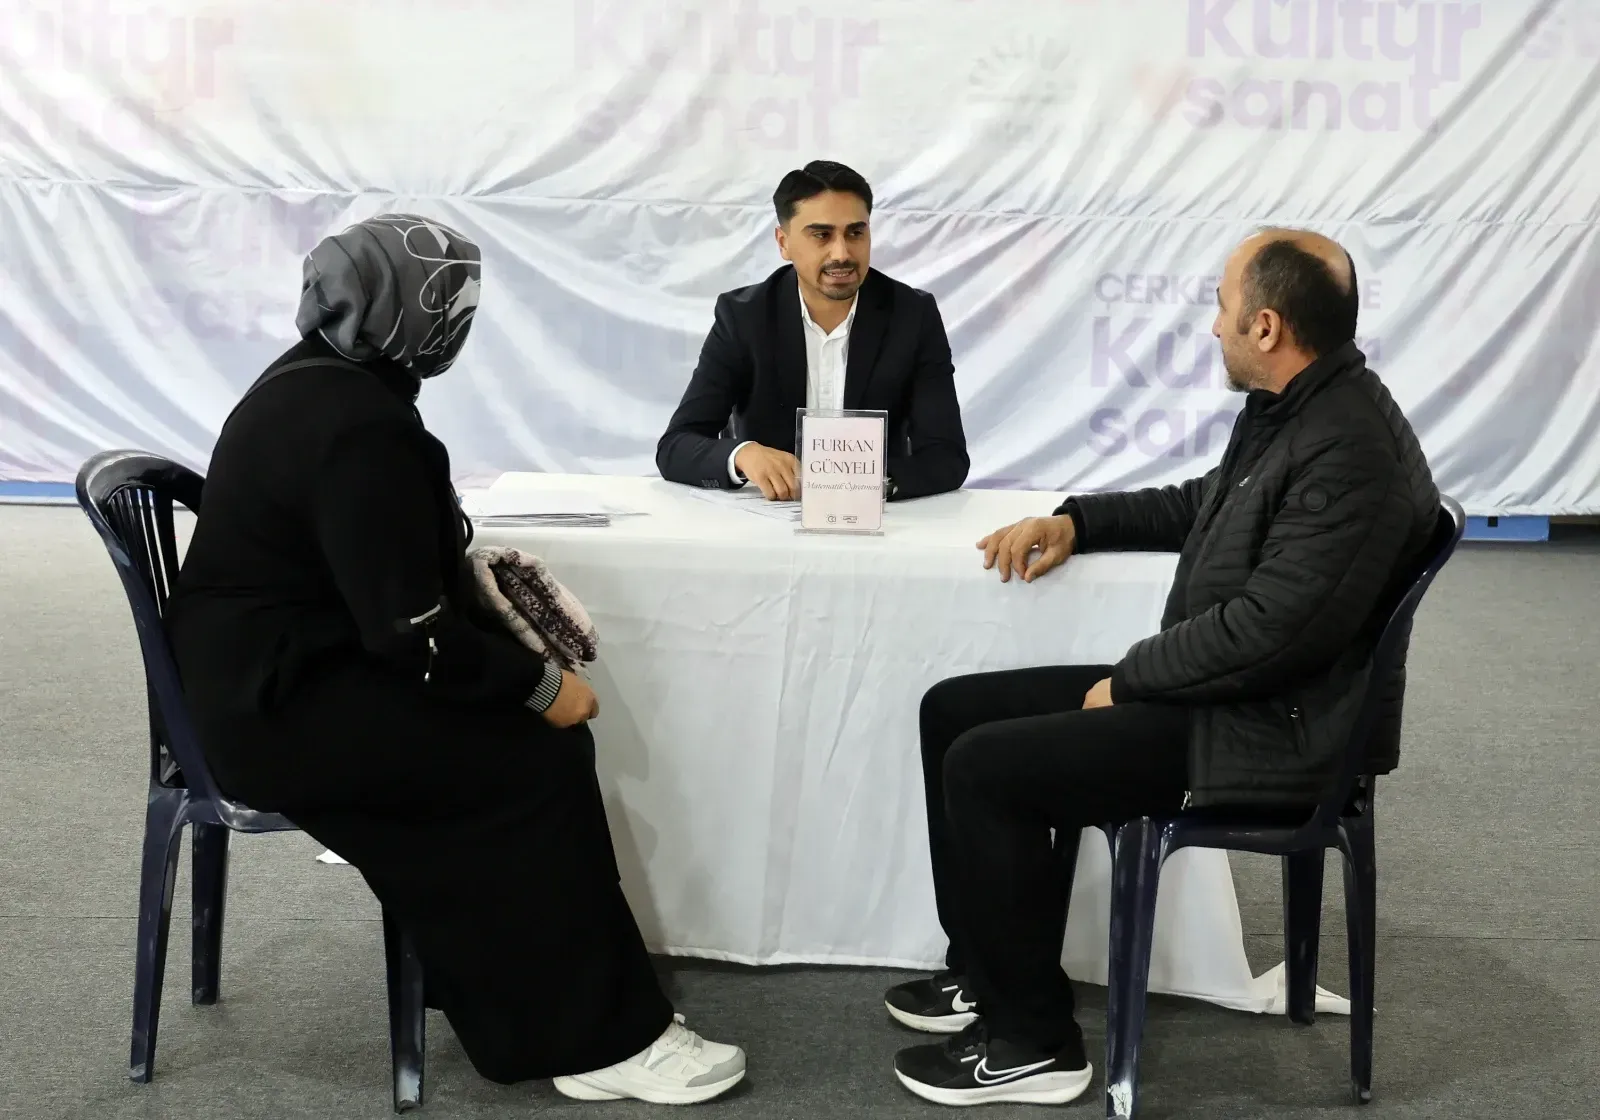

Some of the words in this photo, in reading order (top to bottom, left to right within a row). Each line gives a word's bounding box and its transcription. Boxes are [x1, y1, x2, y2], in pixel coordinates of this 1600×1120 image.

[1186, 0, 1482, 82] Kültür
[574, 88, 840, 151] sanat
[1183, 73, 1443, 133] sanat
[812, 438, 874, 452] FURKAN
[1088, 407, 1238, 459] san
[804, 481, 845, 490] Matematik
[810, 458, 875, 475] GÜNYELİ
